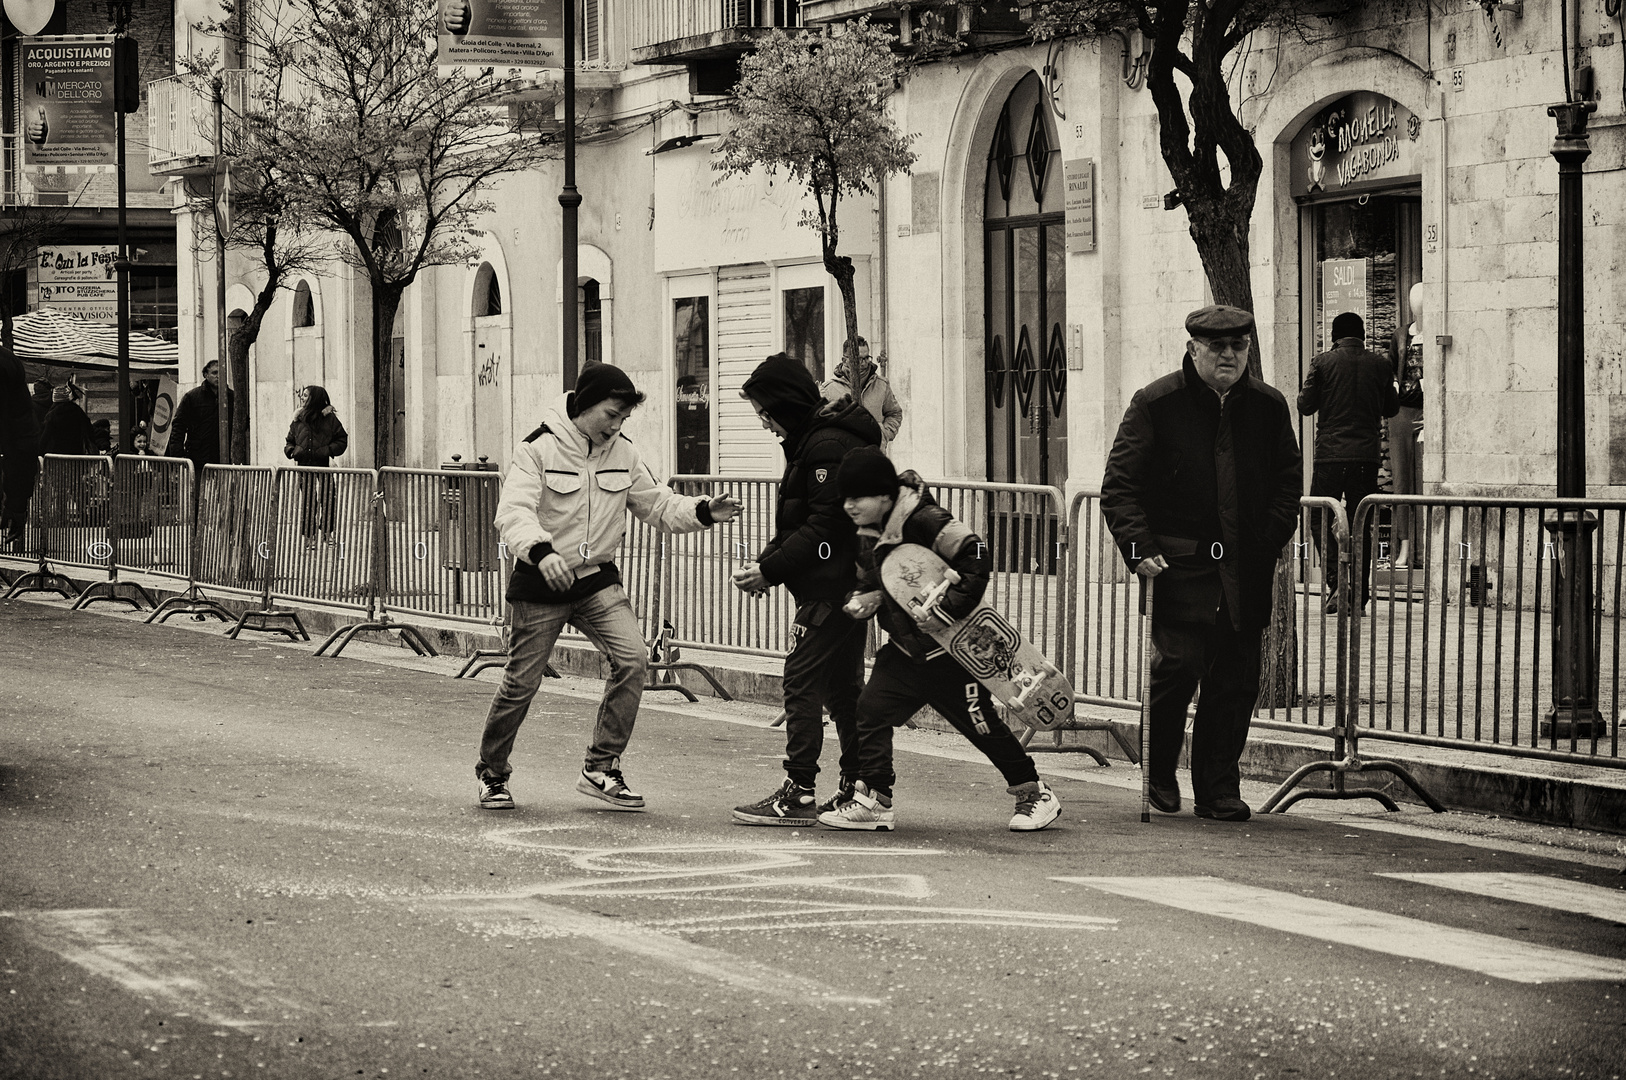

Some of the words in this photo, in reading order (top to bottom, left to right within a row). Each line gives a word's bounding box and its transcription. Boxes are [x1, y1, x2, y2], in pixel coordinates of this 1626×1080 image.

[28, 48, 112, 60] ACQUISTIAMO
[1454, 70, 1462, 86] 55
[58, 82, 102, 90] MERCATO
[58, 90, 102, 98] DELL'ORO
[1337, 135, 1399, 187] VAGABONDA
[1068, 181, 1088, 192] RINALDI
[1428, 225, 1436, 240] 55
[78, 252, 88, 268] la
[91, 251, 118, 266] Fest
[1334, 266, 1354, 286] SALDI
[965, 682, 990, 736] ONZE
